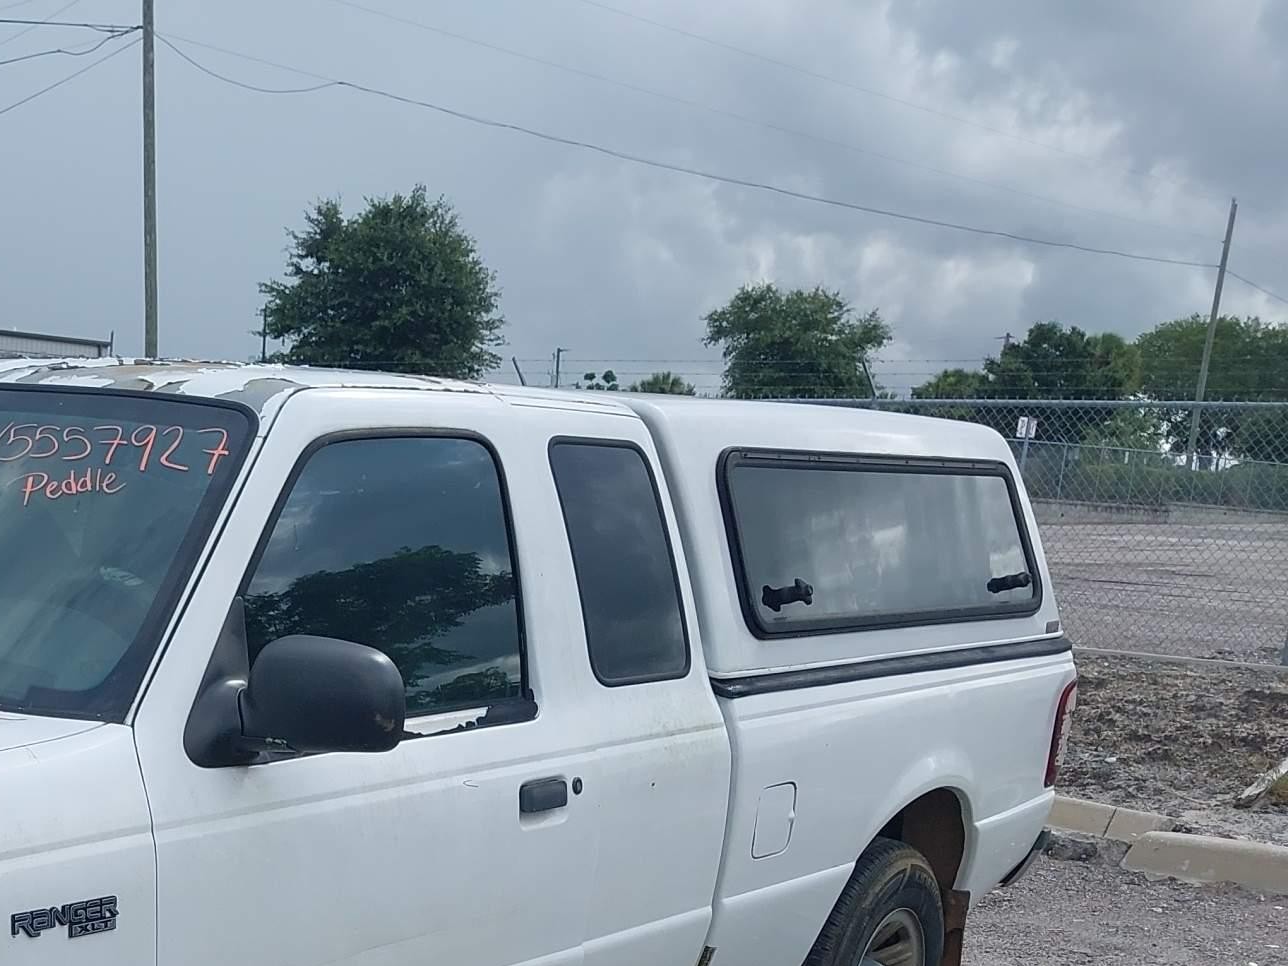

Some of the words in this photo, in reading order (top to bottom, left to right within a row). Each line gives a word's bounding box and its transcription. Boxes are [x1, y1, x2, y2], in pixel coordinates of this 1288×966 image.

[8, 467, 127, 507] Peddle
[10, 894, 120, 938] RANGER
[75, 918, 113, 936] XLT
